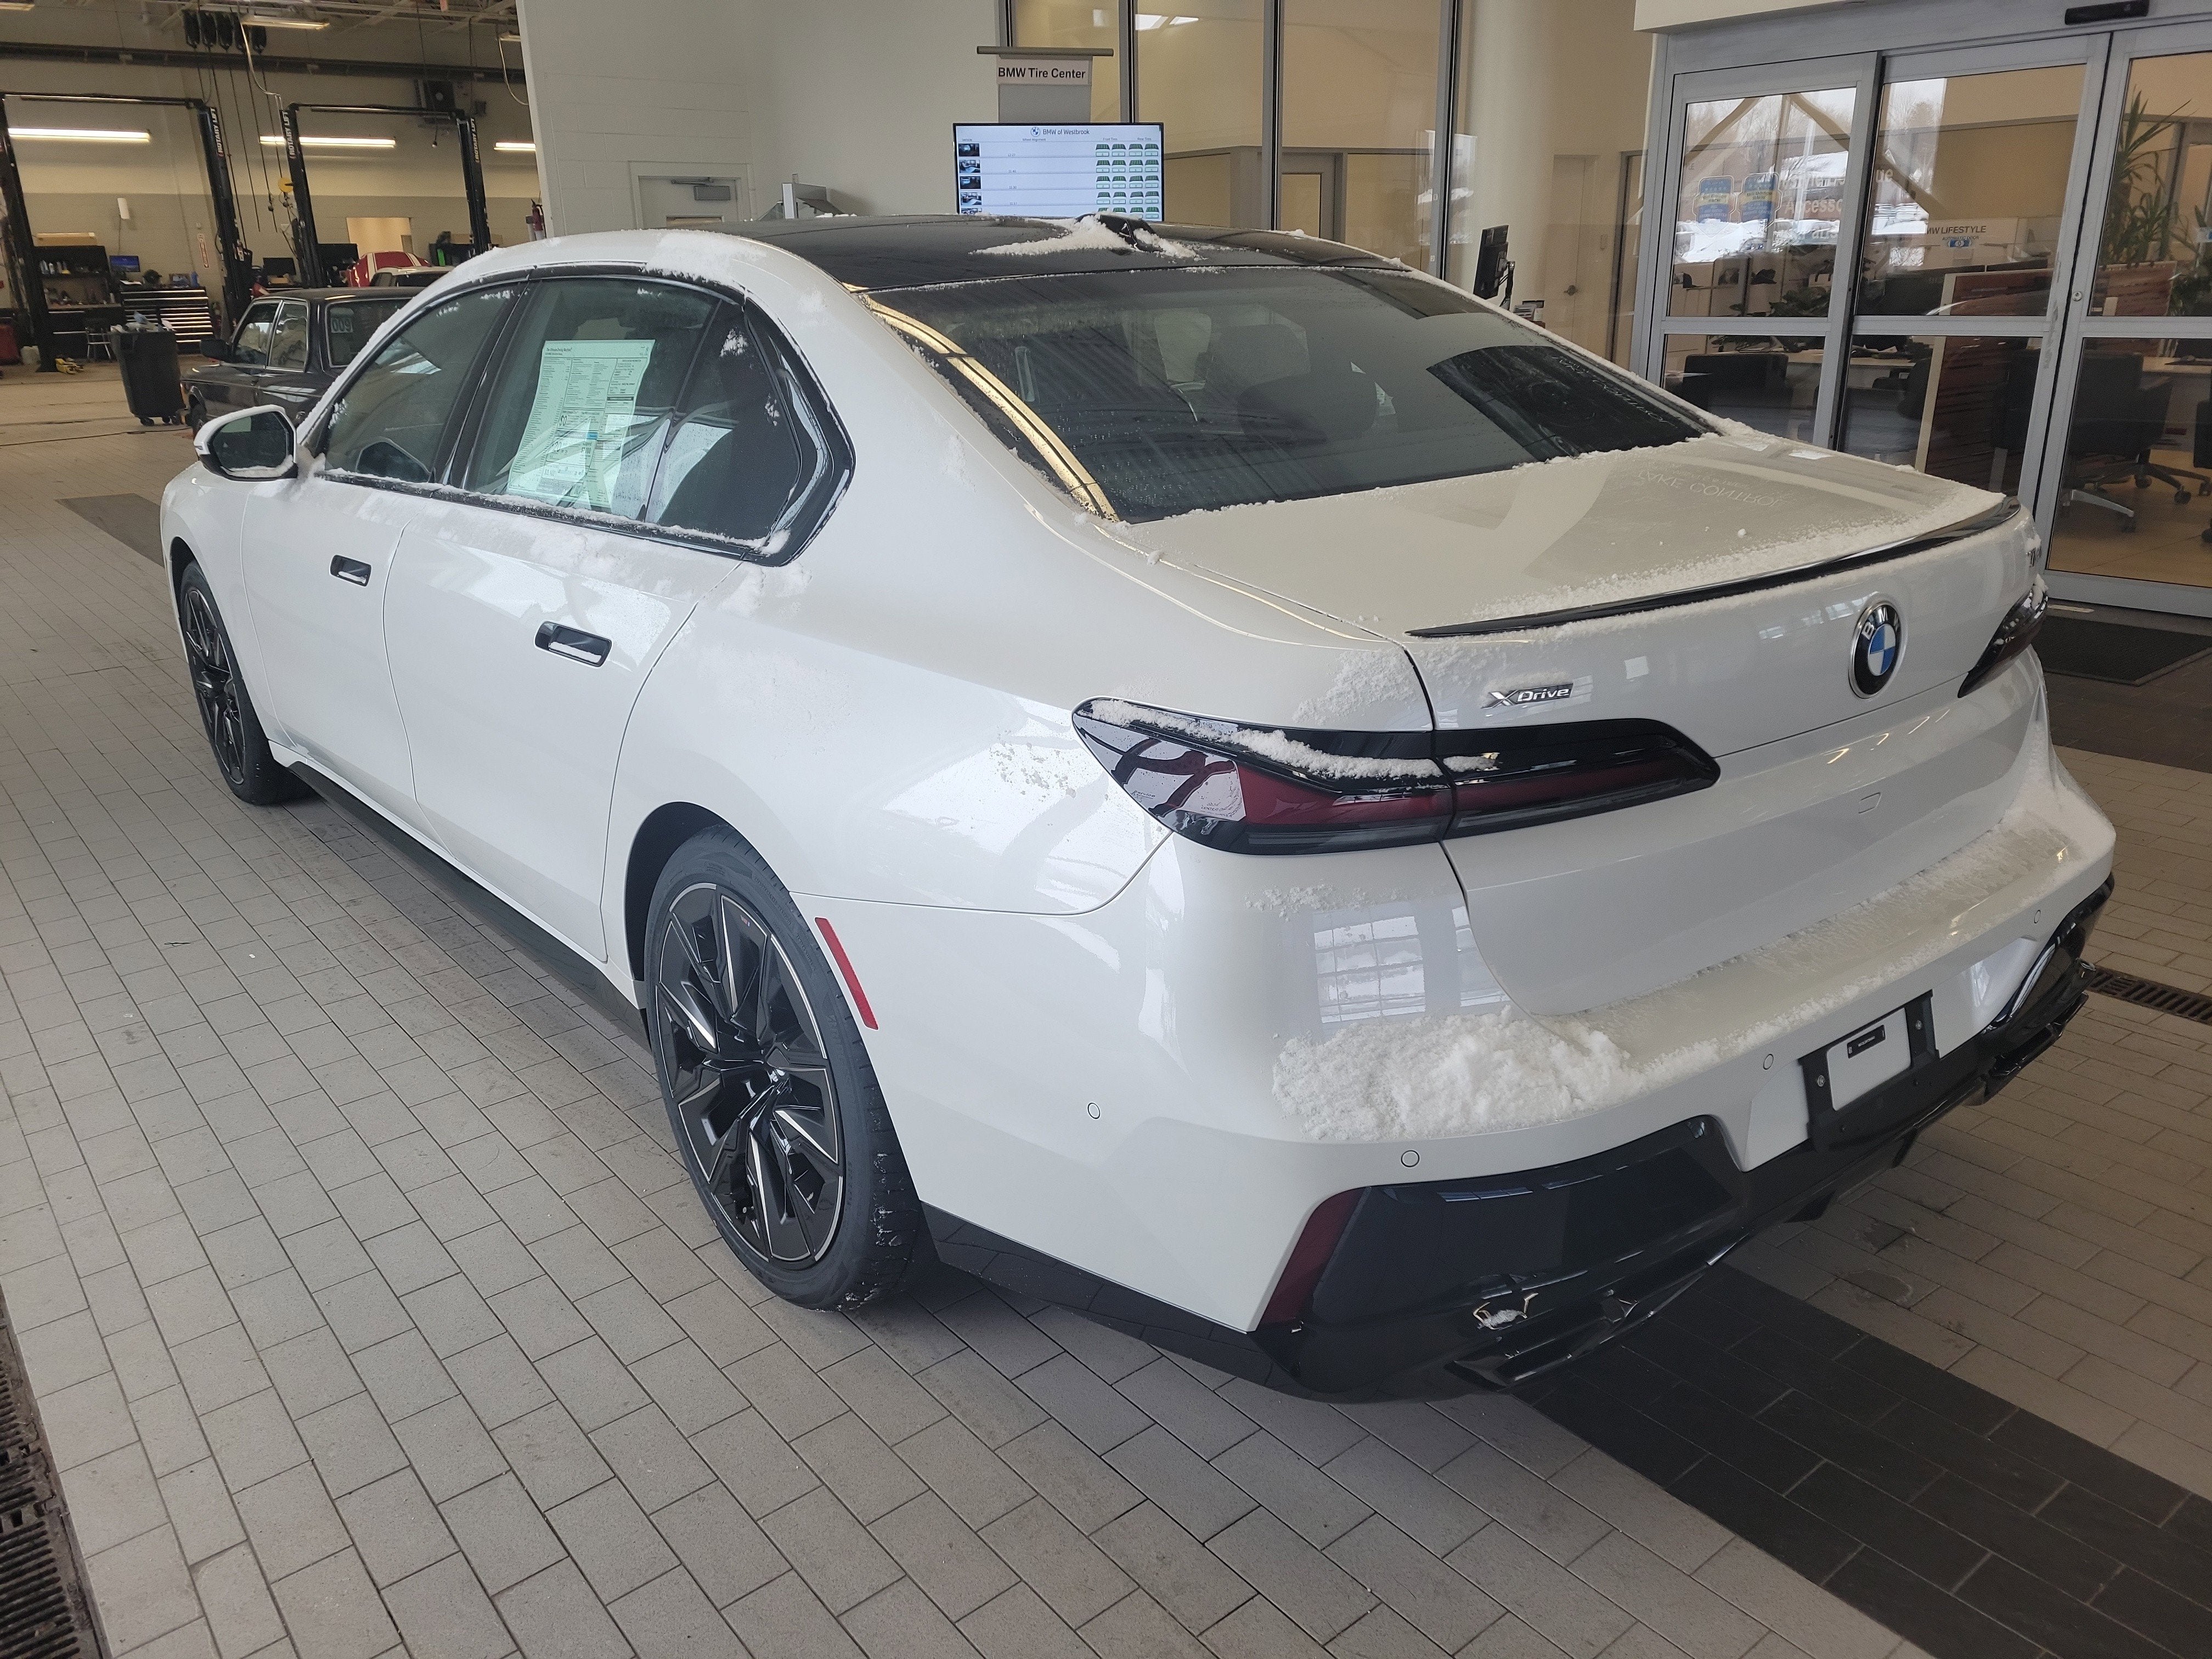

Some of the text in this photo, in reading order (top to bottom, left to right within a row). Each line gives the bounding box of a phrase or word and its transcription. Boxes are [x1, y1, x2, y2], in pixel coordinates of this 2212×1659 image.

[998, 67, 1086, 78] BMW Tire Center
[1941, 225, 1987, 234] LIFESTYLE
